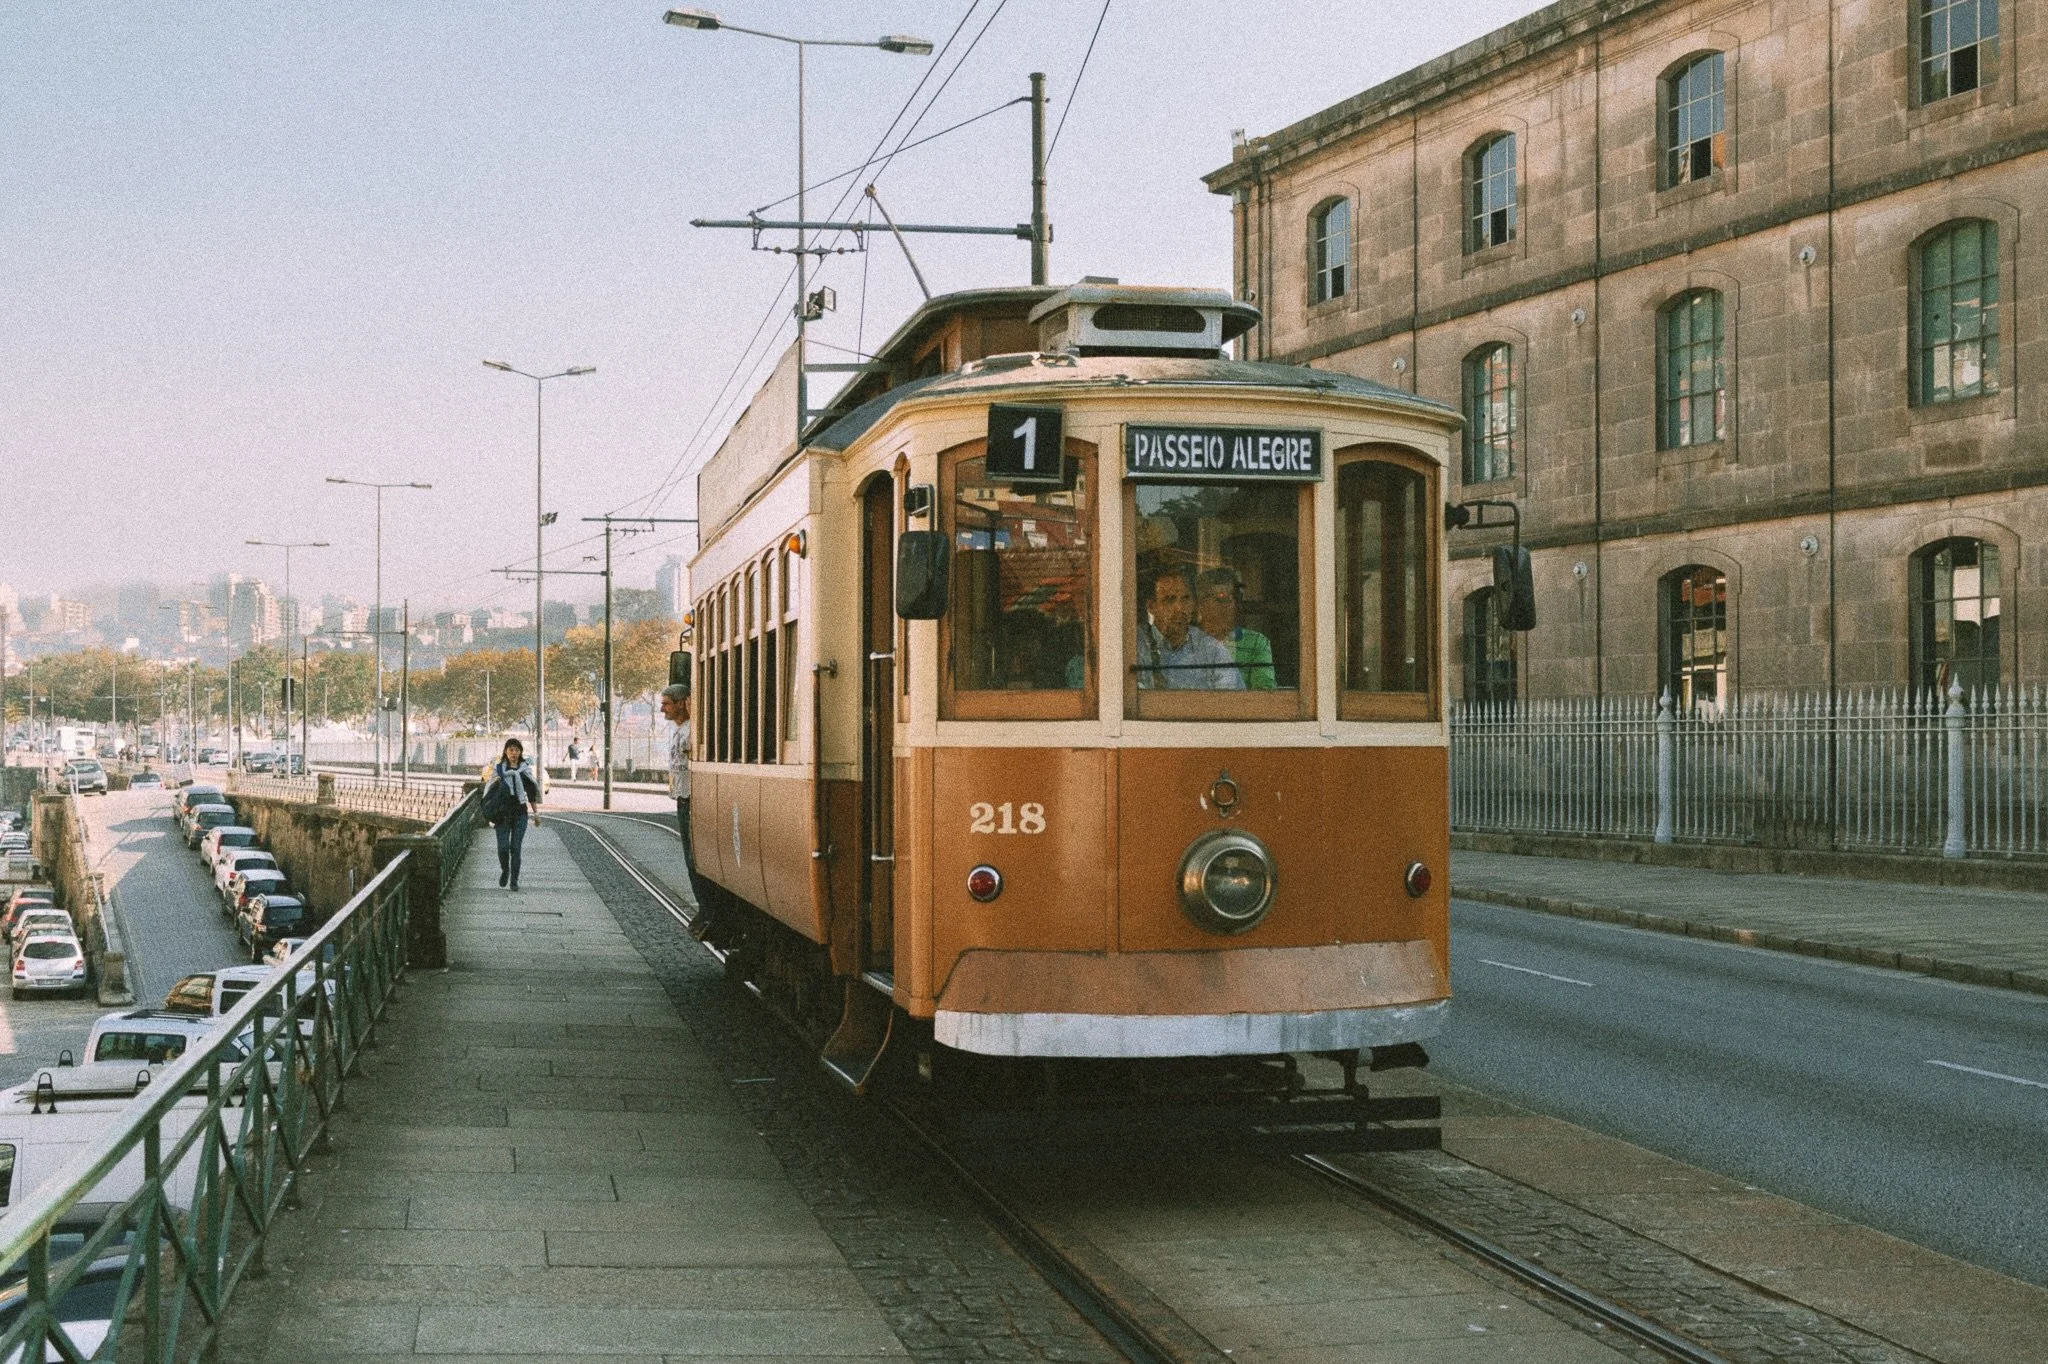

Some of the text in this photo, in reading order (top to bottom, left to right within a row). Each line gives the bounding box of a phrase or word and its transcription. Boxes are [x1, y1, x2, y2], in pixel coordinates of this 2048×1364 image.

[1012, 417, 1037, 470] 1
[1134, 433, 1313, 471] PASSEIO ALEGRE
[969, 802, 1047, 834] 218
